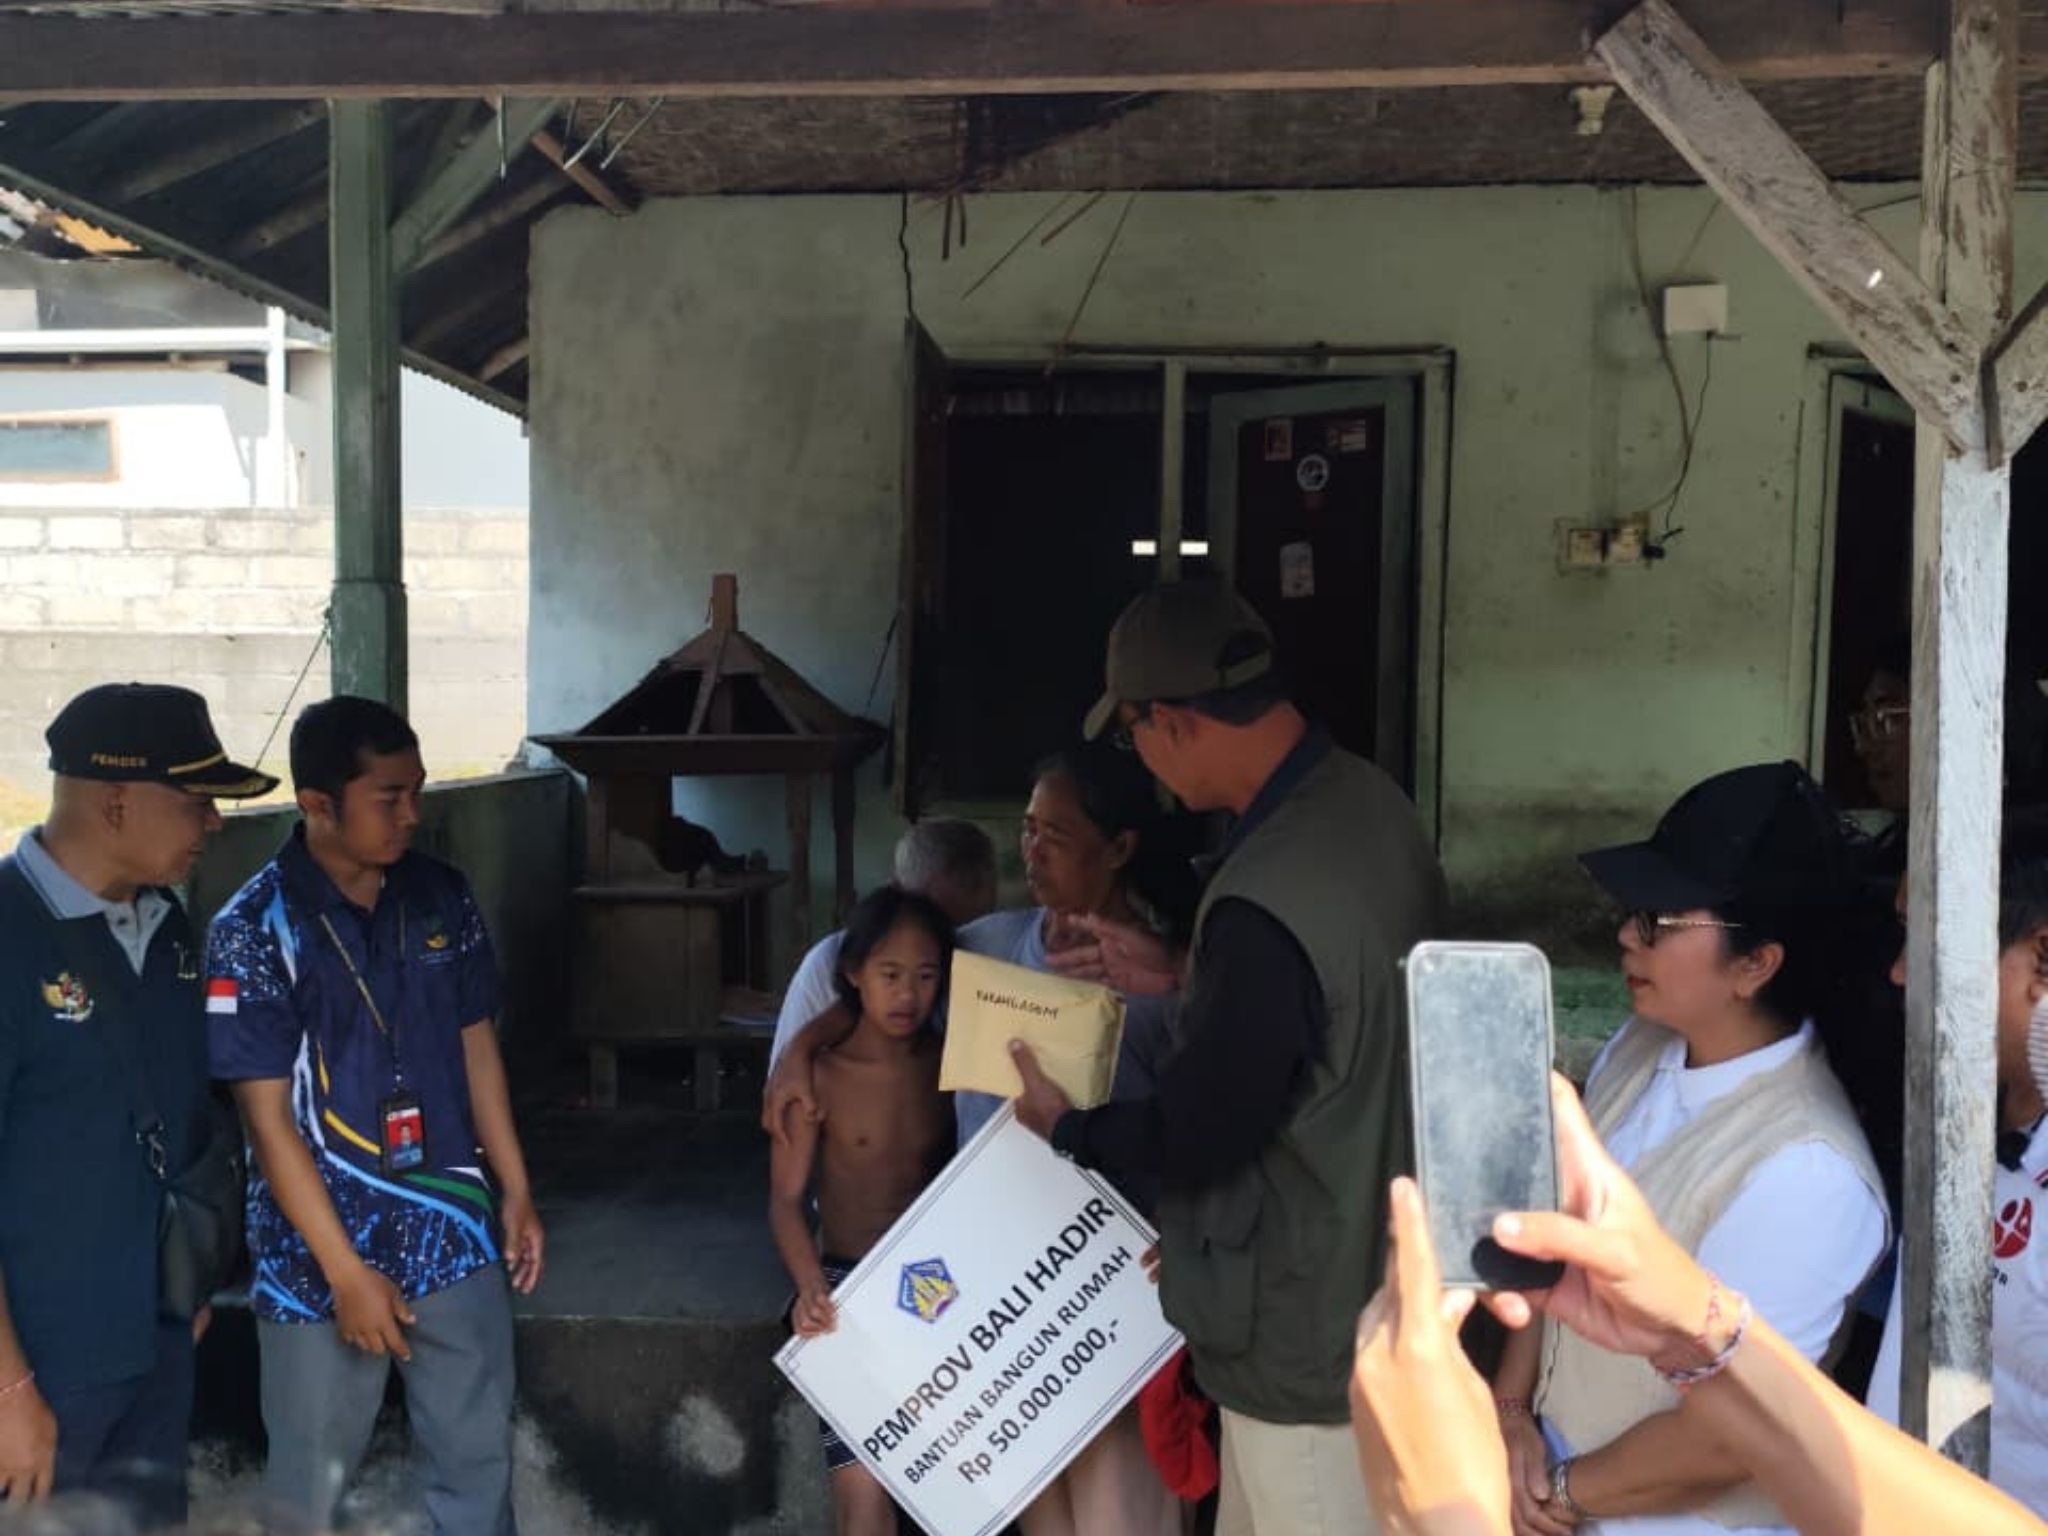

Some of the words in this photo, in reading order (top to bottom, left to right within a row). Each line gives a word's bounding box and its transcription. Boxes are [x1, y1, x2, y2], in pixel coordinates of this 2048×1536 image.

[863, 1344, 973, 1462] PEMPROV
[969, 1284, 1033, 1352] BALI
[1024, 1197, 1115, 1292] HADIR
[904, 1404, 984, 1484] BANTUAN
[979, 1321, 1061, 1408] BANGUN
[1057, 1246, 1132, 1325] RUMAH
[958, 1452, 992, 1484] Rp
[988, 1319, 1118, 1453] 50.000.000,-
